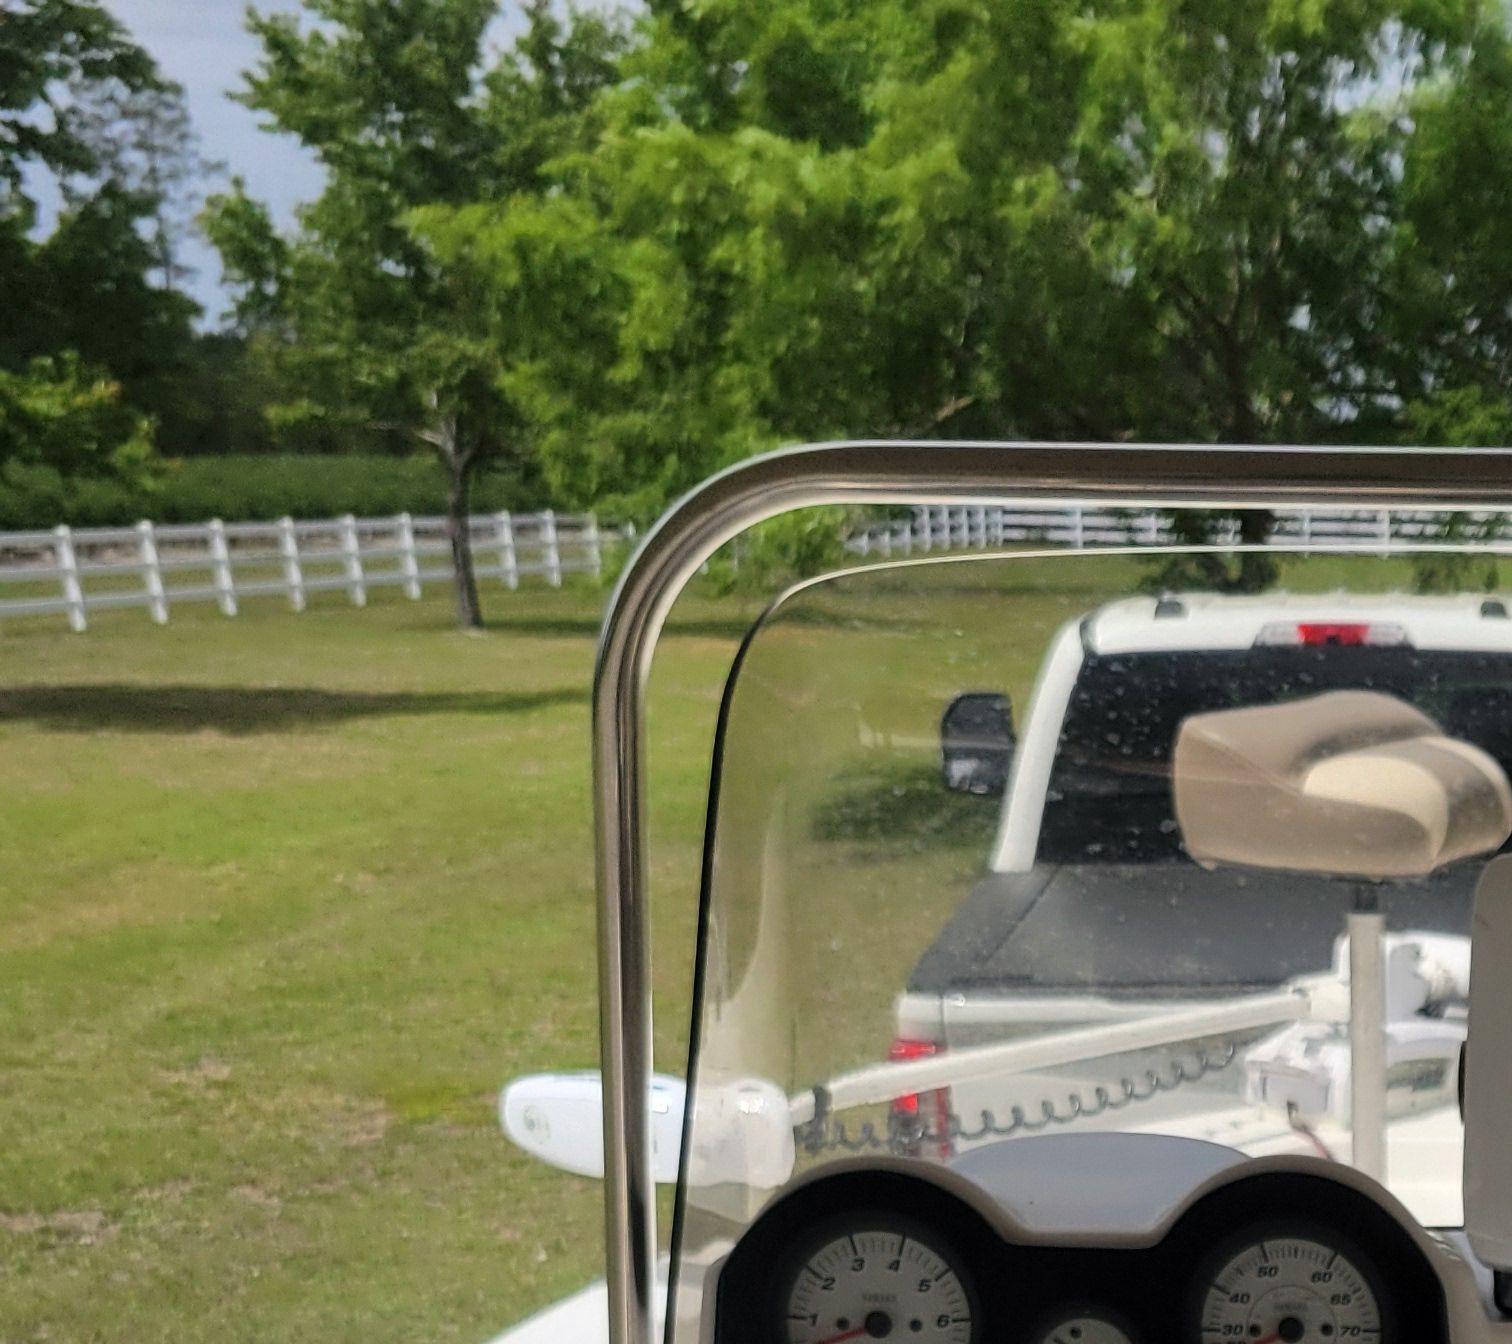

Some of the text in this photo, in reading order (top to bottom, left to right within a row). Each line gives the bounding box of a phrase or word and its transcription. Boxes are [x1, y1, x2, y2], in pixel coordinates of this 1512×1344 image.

[852, 1259, 865, 1273] 3
[888, 1259, 901, 1273] 4
[1257, 1266, 1279, 1278] 50
[822, 1276, 836, 1291] 2
[1312, 1272, 1332, 1284] 60
[918, 1278, 931, 1293] 5
[1229, 1292, 1251, 1304] 40
[1331, 1294, 1352, 1305] 65
[807, 1314, 818, 1327] 1
[937, 1314, 950, 1328] 6
[1222, 1325, 1244, 1336] 30
[1340, 1326, 1361, 1337] 70
